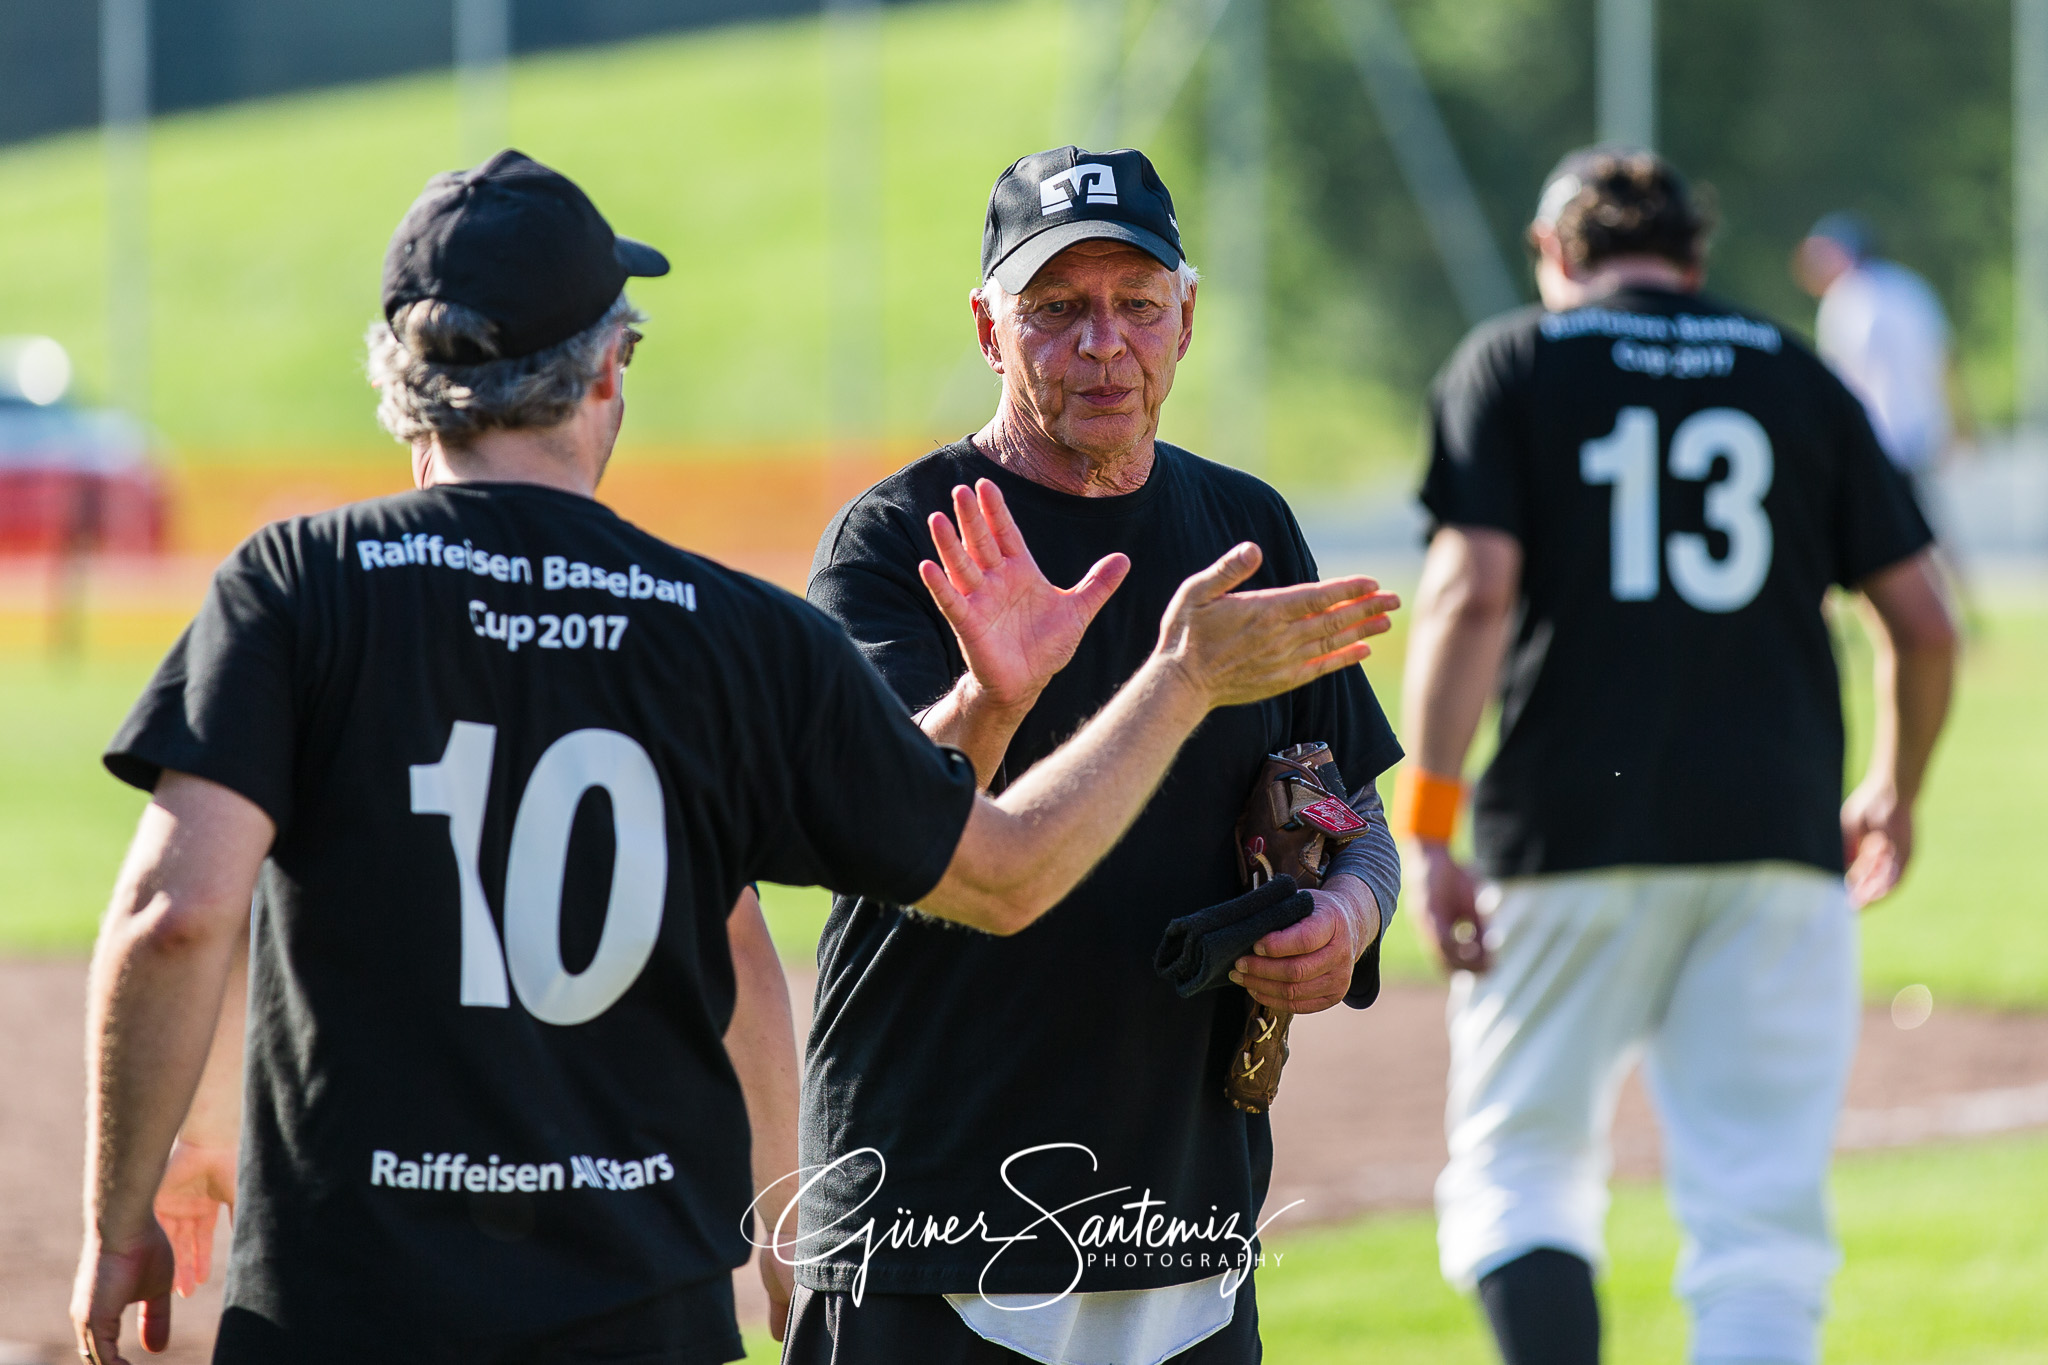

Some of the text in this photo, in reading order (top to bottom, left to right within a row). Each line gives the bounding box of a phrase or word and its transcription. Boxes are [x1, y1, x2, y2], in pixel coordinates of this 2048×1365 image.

[356, 533, 697, 611] Raiffeisen Baseball
[1579, 405, 1775, 614] 13
[409, 720, 668, 1026] 10
[370, 1150, 565, 1192] Raiffeisen
